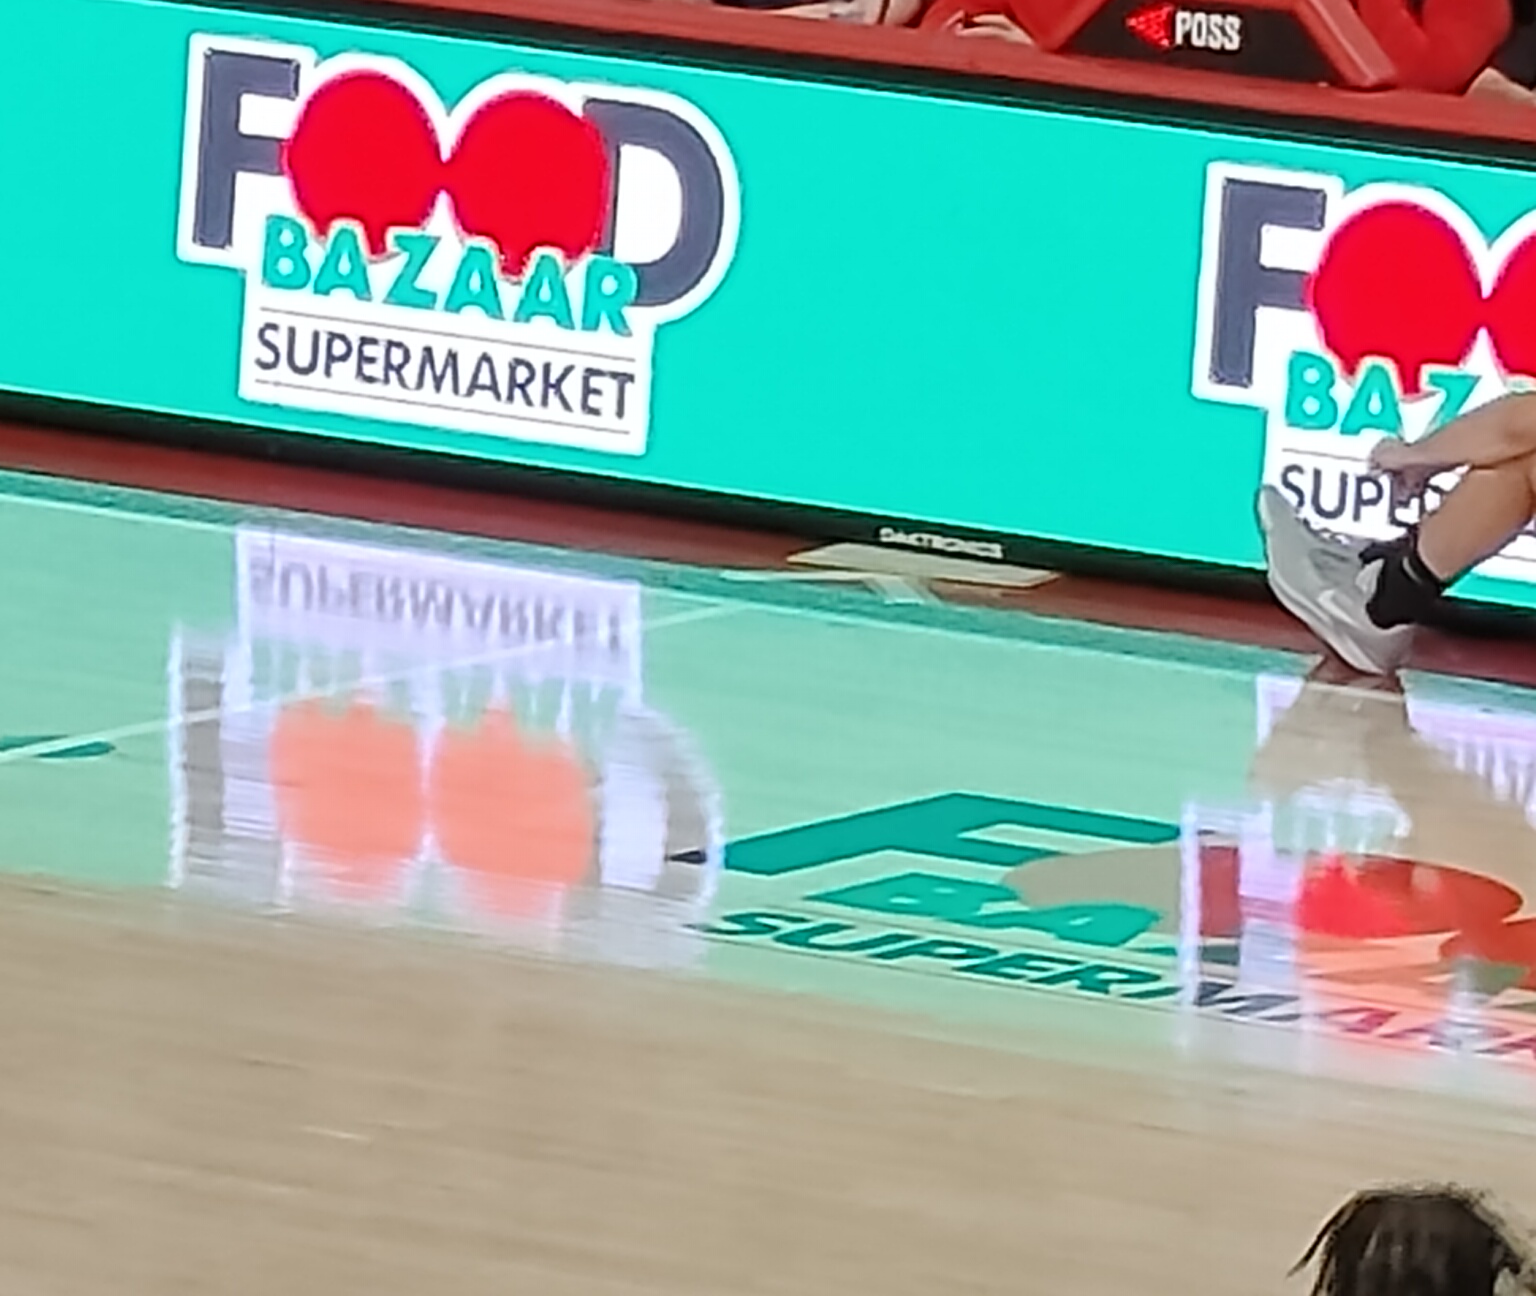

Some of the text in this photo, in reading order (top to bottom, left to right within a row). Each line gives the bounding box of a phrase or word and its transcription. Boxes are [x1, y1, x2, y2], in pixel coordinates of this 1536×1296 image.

[1175, 10, 1241, 51] POSS
[193, 48, 726, 309] FOOD
[262, 215, 642, 336] BAZAAR
[255, 323, 636, 422] SUPERMARKET
